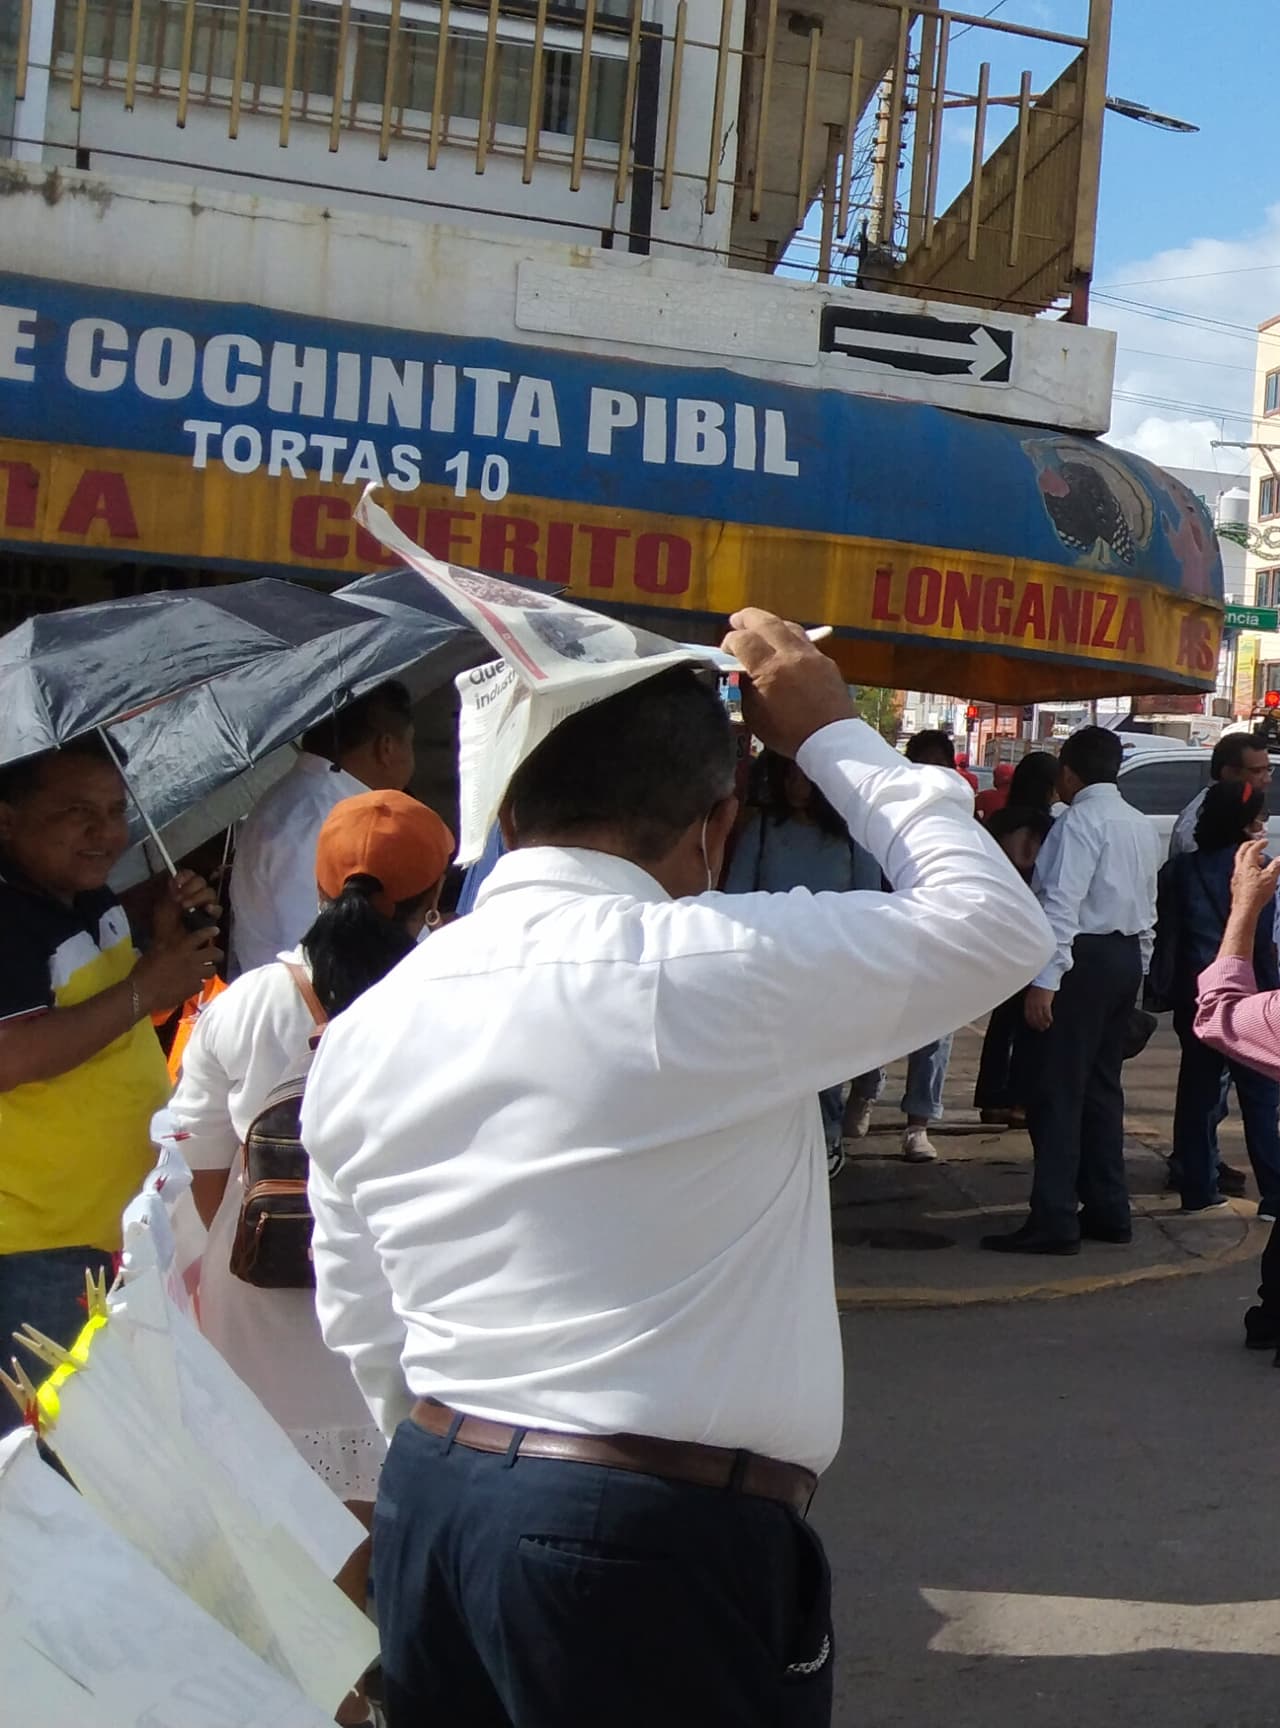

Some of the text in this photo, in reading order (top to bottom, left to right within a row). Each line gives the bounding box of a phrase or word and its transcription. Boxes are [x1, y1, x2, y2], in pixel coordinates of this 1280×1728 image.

[65, 317, 561, 447] COCHINITA
[587, 387, 799, 476] PIBIL
[183, 419, 509, 500] TORTAS 10
[871, 566, 1145, 653] LONGANIZA
[1224, 612, 1259, 625] ncia
[469, 660, 505, 685] Que
